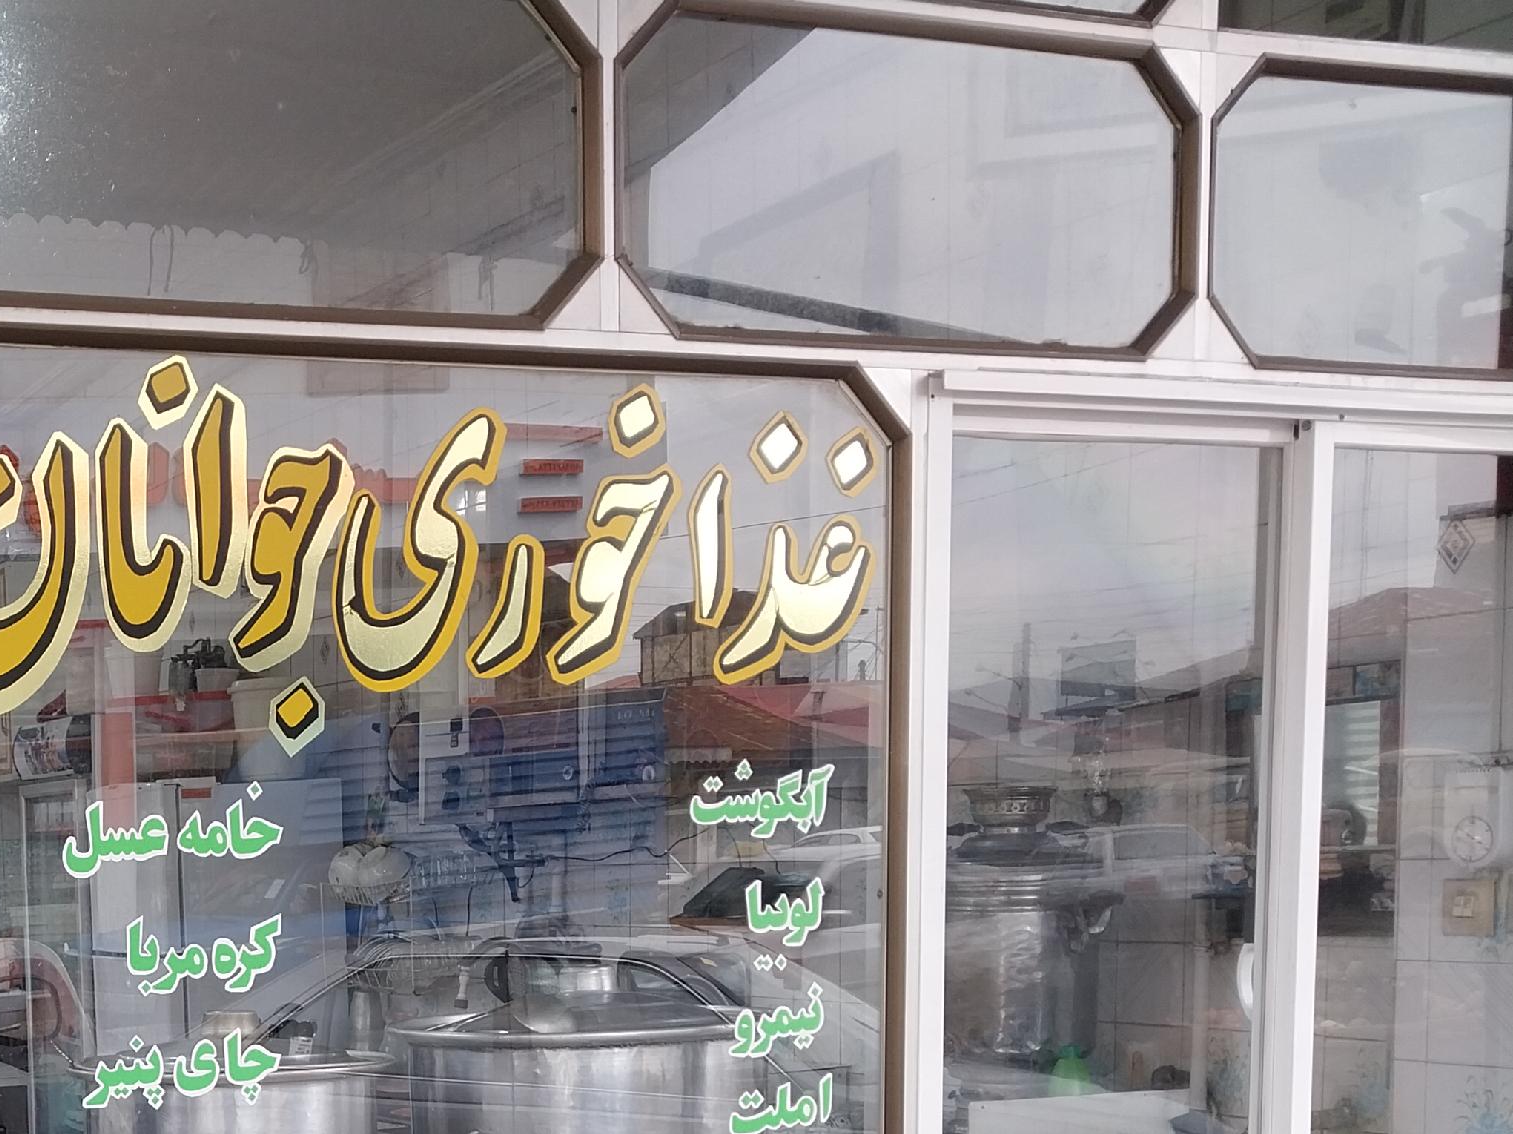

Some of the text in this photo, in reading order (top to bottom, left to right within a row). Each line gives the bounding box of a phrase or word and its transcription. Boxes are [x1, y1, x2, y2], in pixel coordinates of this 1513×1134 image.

[62, 781, 284, 878] خامه عسل
[689, 759, 835, 838] آبگوشت
[126, 913, 282, 996] کره مربا
[746, 878, 826, 971] لوبیا
[729, 982, 824, 1058] نیمرو
[82, 1028, 282, 1109] چای پنیر
